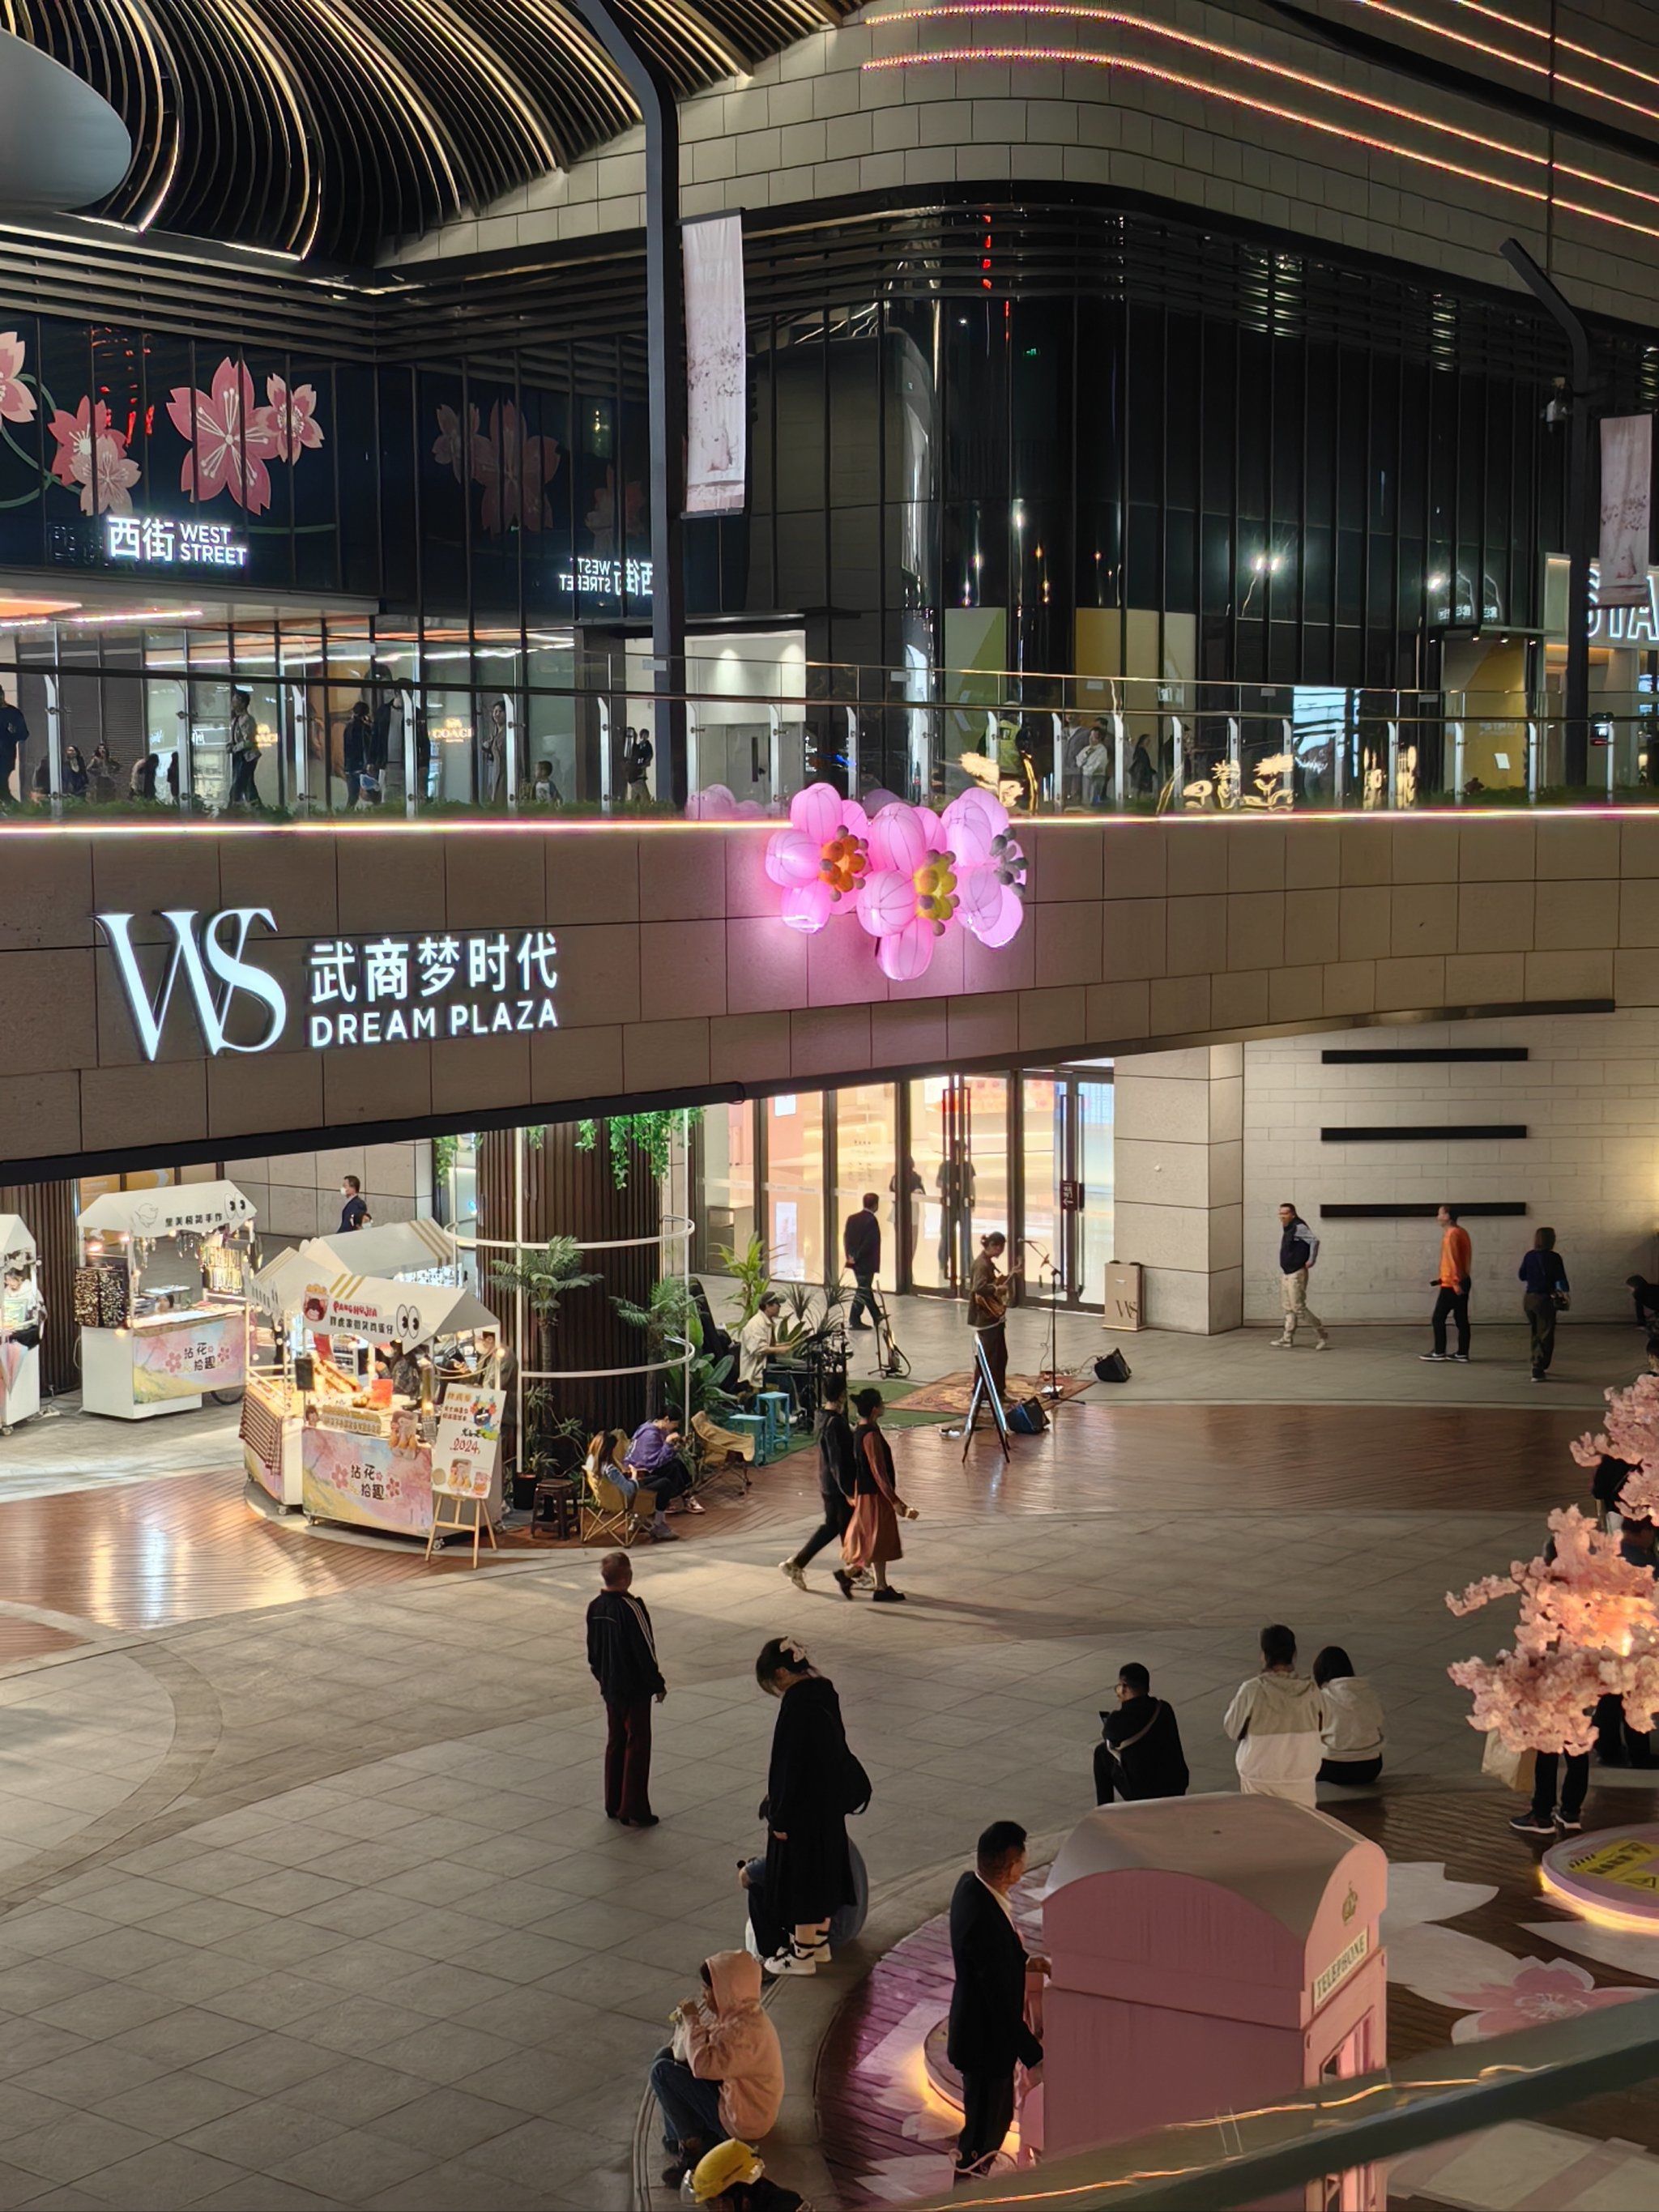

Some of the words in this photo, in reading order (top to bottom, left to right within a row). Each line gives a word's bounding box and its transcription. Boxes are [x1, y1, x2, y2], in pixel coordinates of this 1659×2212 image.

[108, 516, 175, 561] 西街
[180, 523, 231, 544] WEST
[180, 543, 247, 565] STREET
[91, 908, 287, 1062] WS
[310, 931, 559, 1004] 武商梦时代
[310, 1007, 437, 1048] DREAM
[451, 999, 559, 1035] PLAZA
[1316, 1933, 1365, 1998] TELEPHONE
